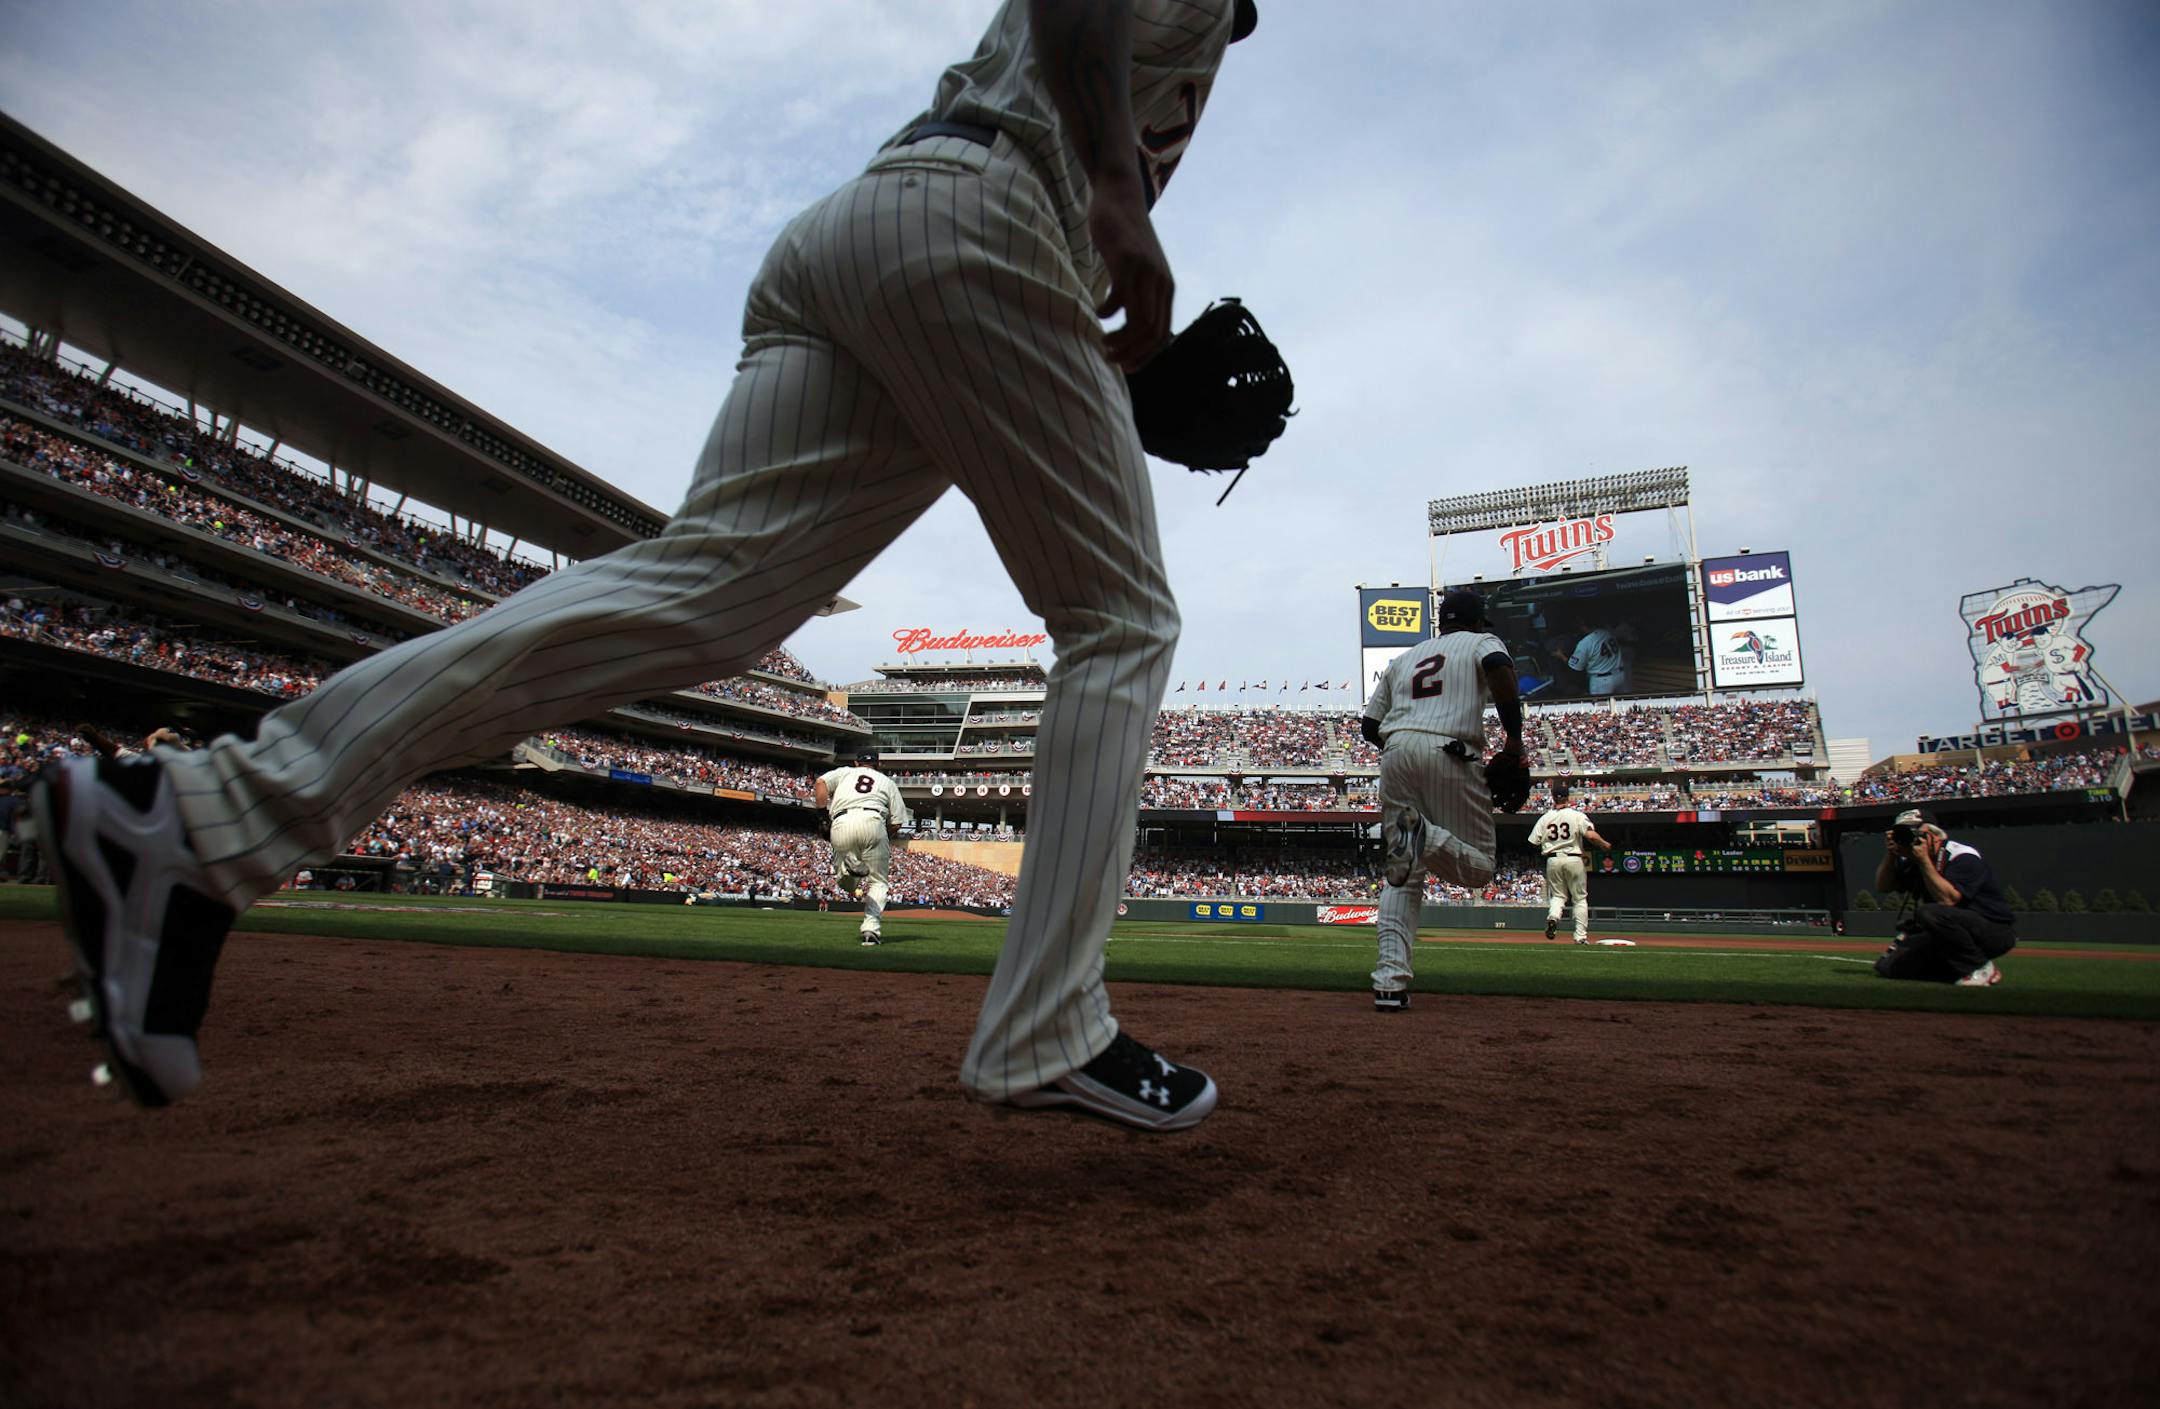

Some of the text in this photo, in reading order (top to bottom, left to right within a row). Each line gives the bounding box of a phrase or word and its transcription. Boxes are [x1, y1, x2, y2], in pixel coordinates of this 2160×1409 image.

[1500, 514, 1616, 571] Twins
[1375, 605, 1420, 617] BEST
[1376, 616, 1415, 627] BUY
[1974, 597, 2070, 645] Twins
[892, 628, 1047, 653] Budweiser
[1720, 651, 1792, 665] Treasure Island
[1412, 654, 1446, 700] 2
[1920, 726, 2044, 753] TARGET
[855, 774, 875, 793] 8
[1547, 822, 1570, 841] 33
